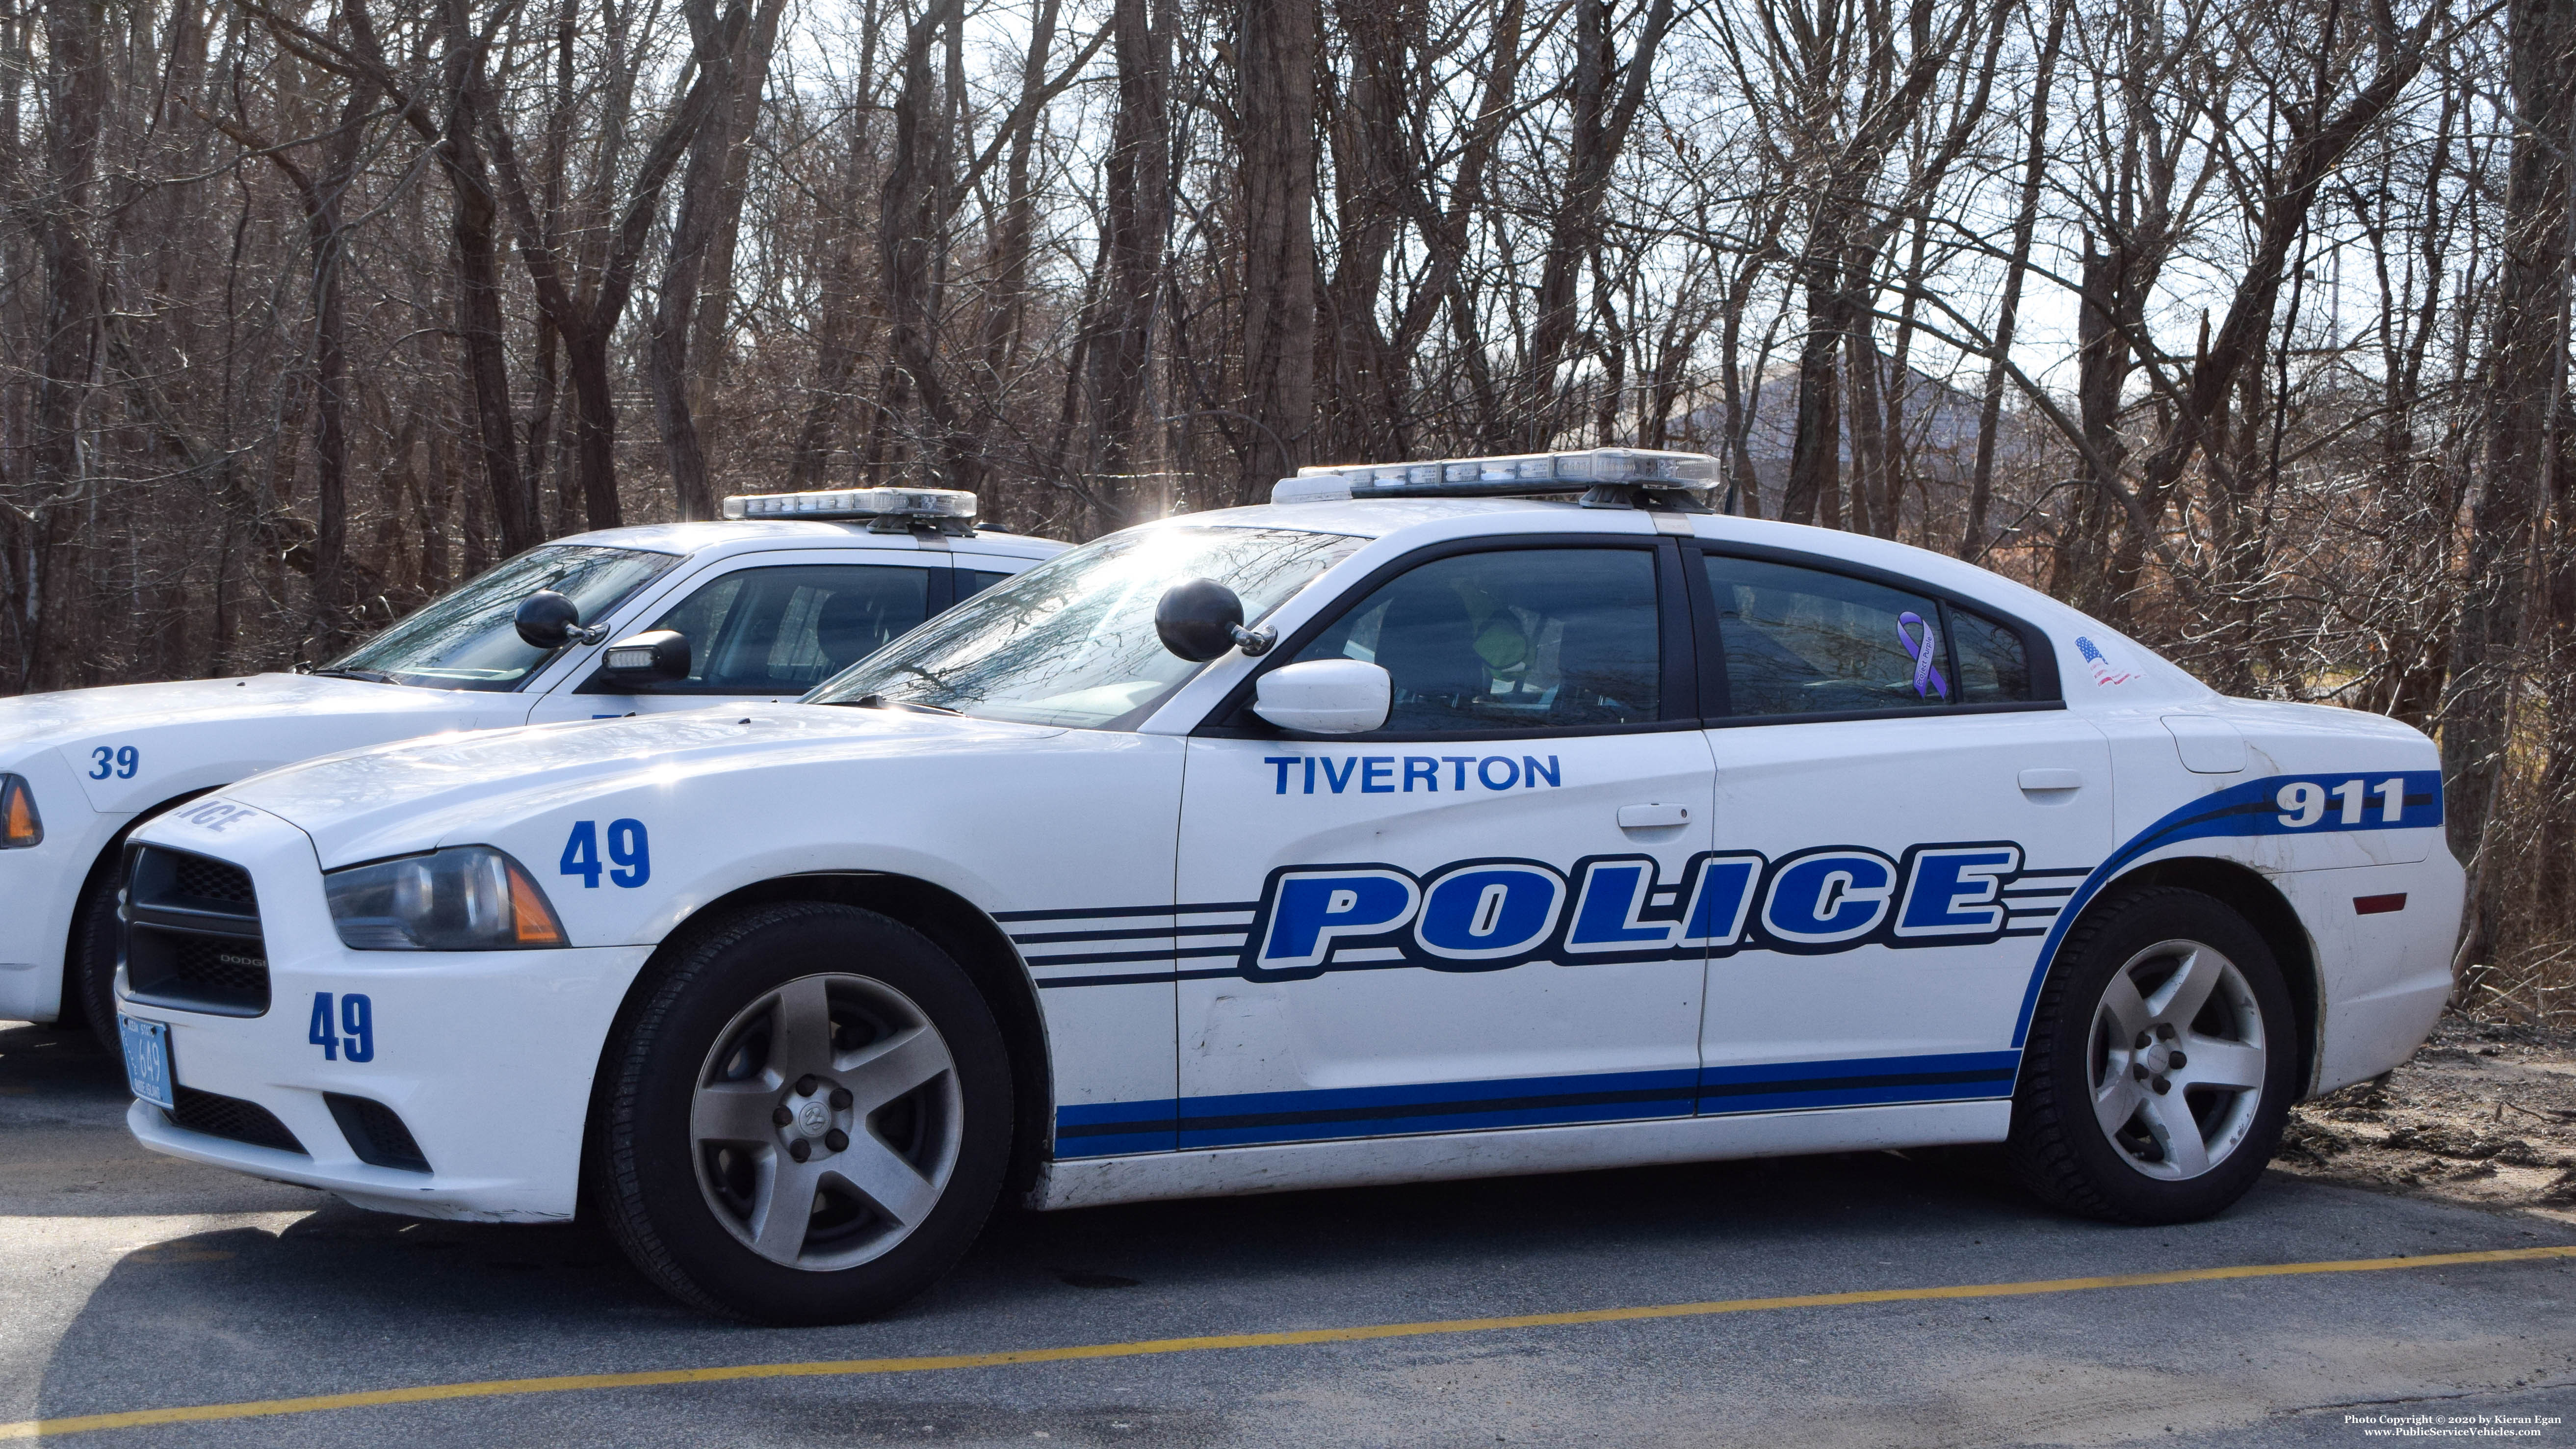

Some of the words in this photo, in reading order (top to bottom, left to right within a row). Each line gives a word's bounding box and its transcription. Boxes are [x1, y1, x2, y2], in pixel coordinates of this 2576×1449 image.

[1916, 660, 1927, 686] Project
[1923, 636, 1932, 658] Purple
[89, 745, 139, 780] 39
[1264, 755, 1561, 794] TIVERTON
[174, 800, 258, 832] ICE
[2276, 778, 2403, 827] 911
[560, 818, 651, 888] 49
[1254, 844, 2021, 974] POLICE
[309, 991, 374, 1063] 49
[139, 1038, 160, 1082] 649
